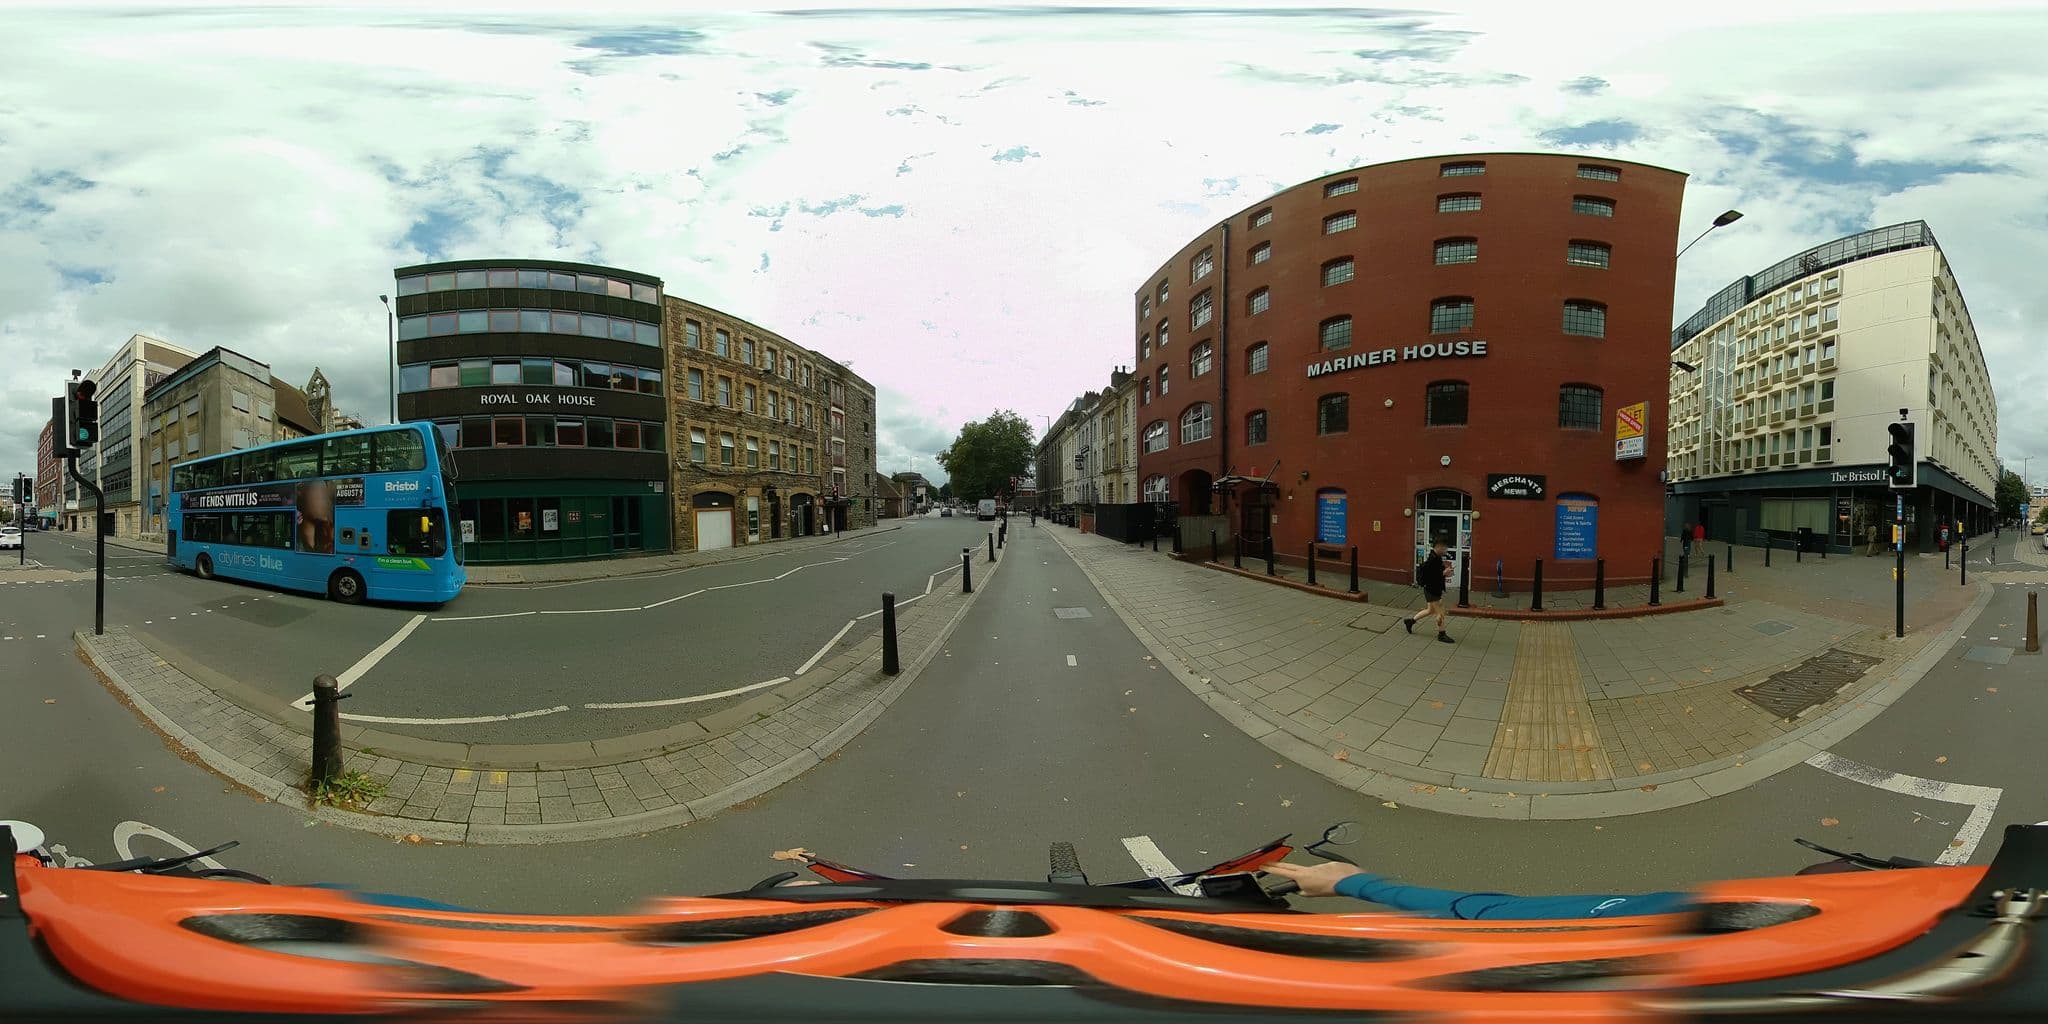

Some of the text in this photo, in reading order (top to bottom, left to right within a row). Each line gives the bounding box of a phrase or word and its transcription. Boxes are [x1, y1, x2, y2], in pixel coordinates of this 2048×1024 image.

[1307, 341, 1487, 377] MARINER HOUSE
[480, 394, 596, 406] ROYAL OAK HOUSE
[1830, 471, 1848, 481] The
[1849, 469, 1880, 481] Bristol
[385, 480, 419, 491] Bristol
[1491, 476, 1543, 494] MERCHANTS
[336, 488, 363, 497] AUGUST 9
[200, 496, 206, 508] IT
[206, 494, 225, 507] ENDS
[224, 493, 245, 507] WITH
[246, 492, 258, 506] US
[219, 551, 283, 570] citylines blue
